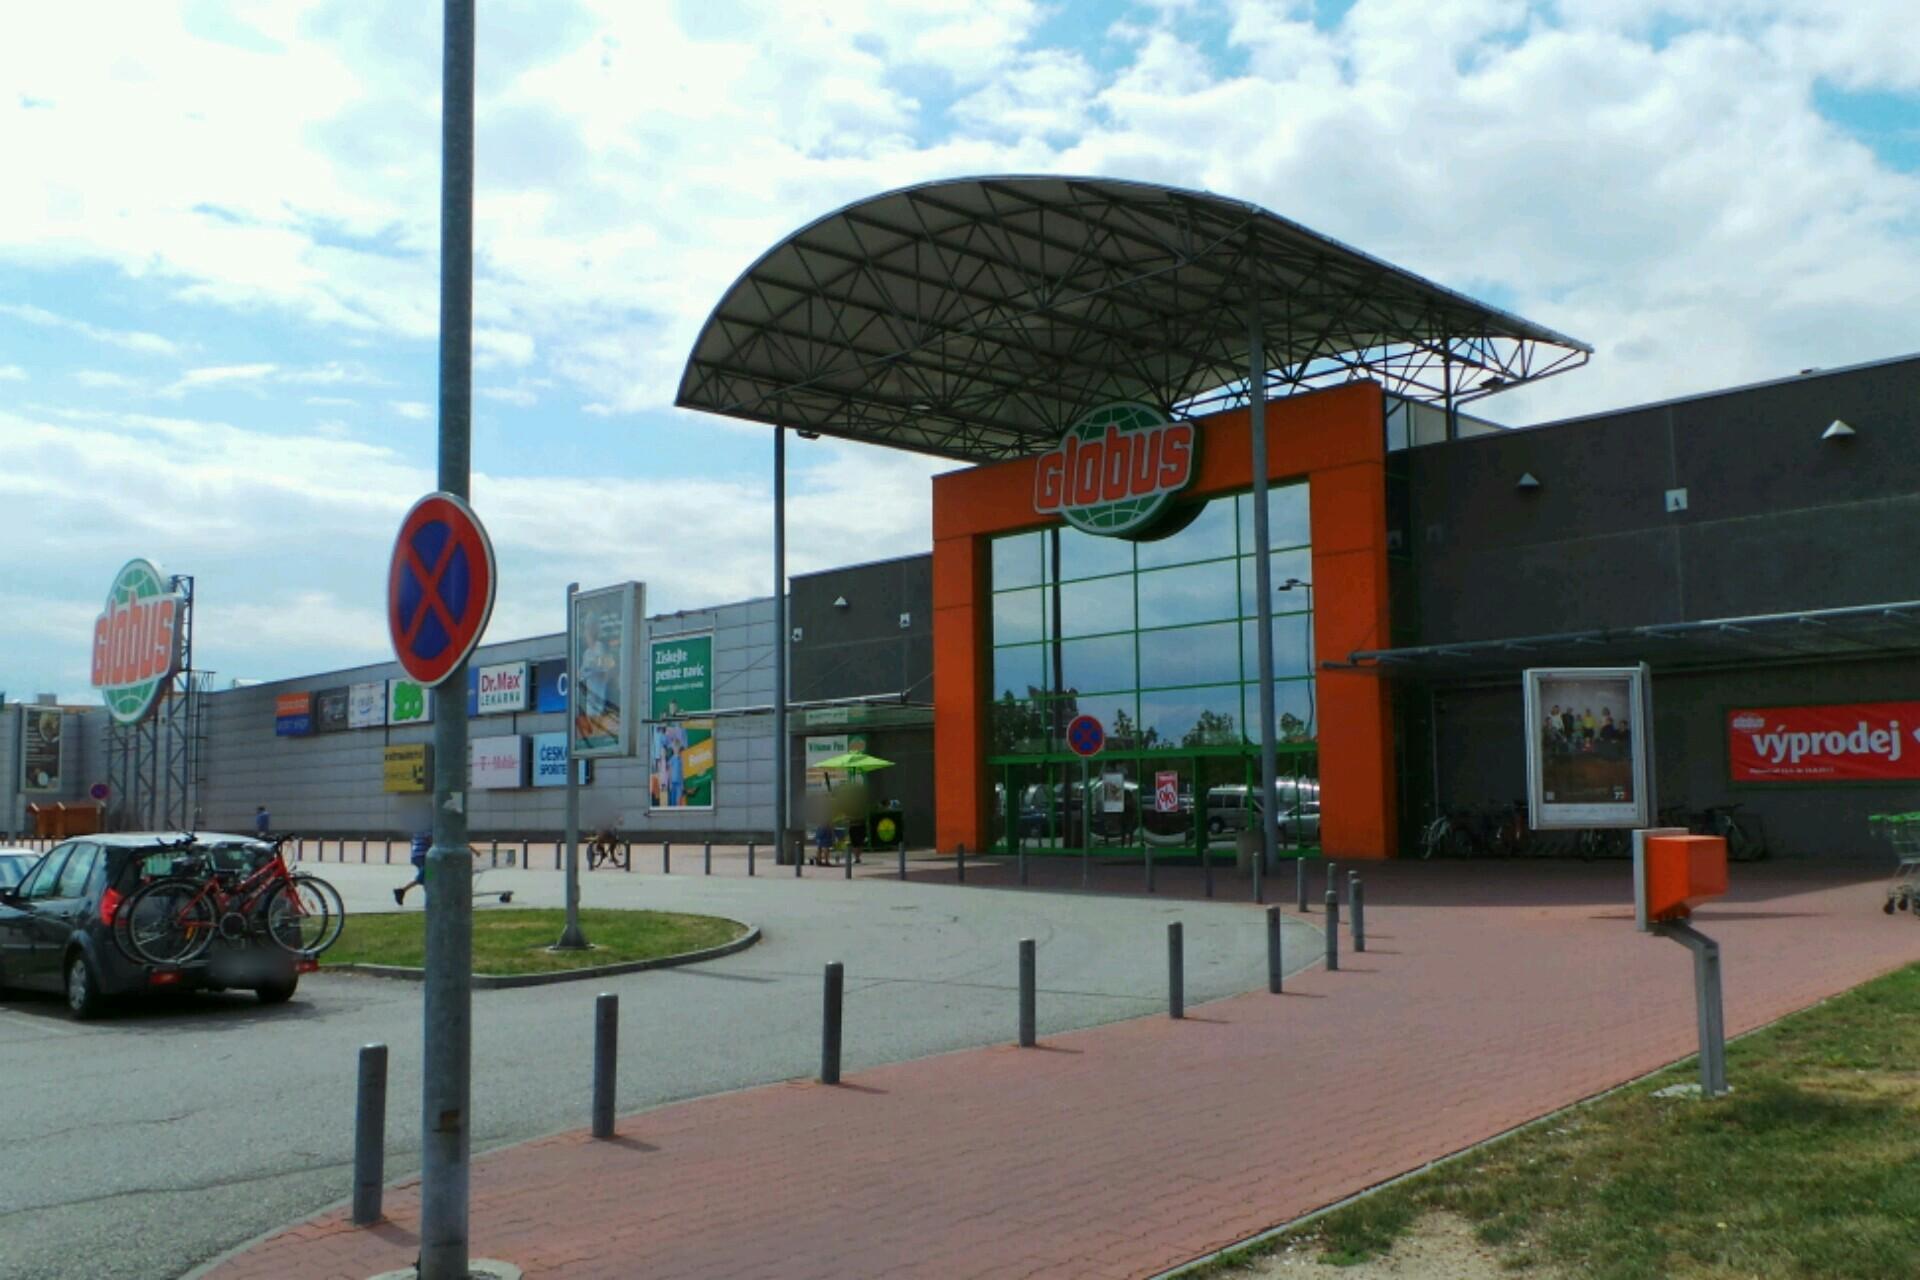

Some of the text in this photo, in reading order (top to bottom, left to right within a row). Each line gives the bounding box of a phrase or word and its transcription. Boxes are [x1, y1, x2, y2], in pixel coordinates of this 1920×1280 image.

[1038, 425, 1192, 509] Globus
[94, 591, 175, 687] Globus
[481, 671, 521, 693] Dr.Max
[1751, 719, 1902, 764] výprodej
